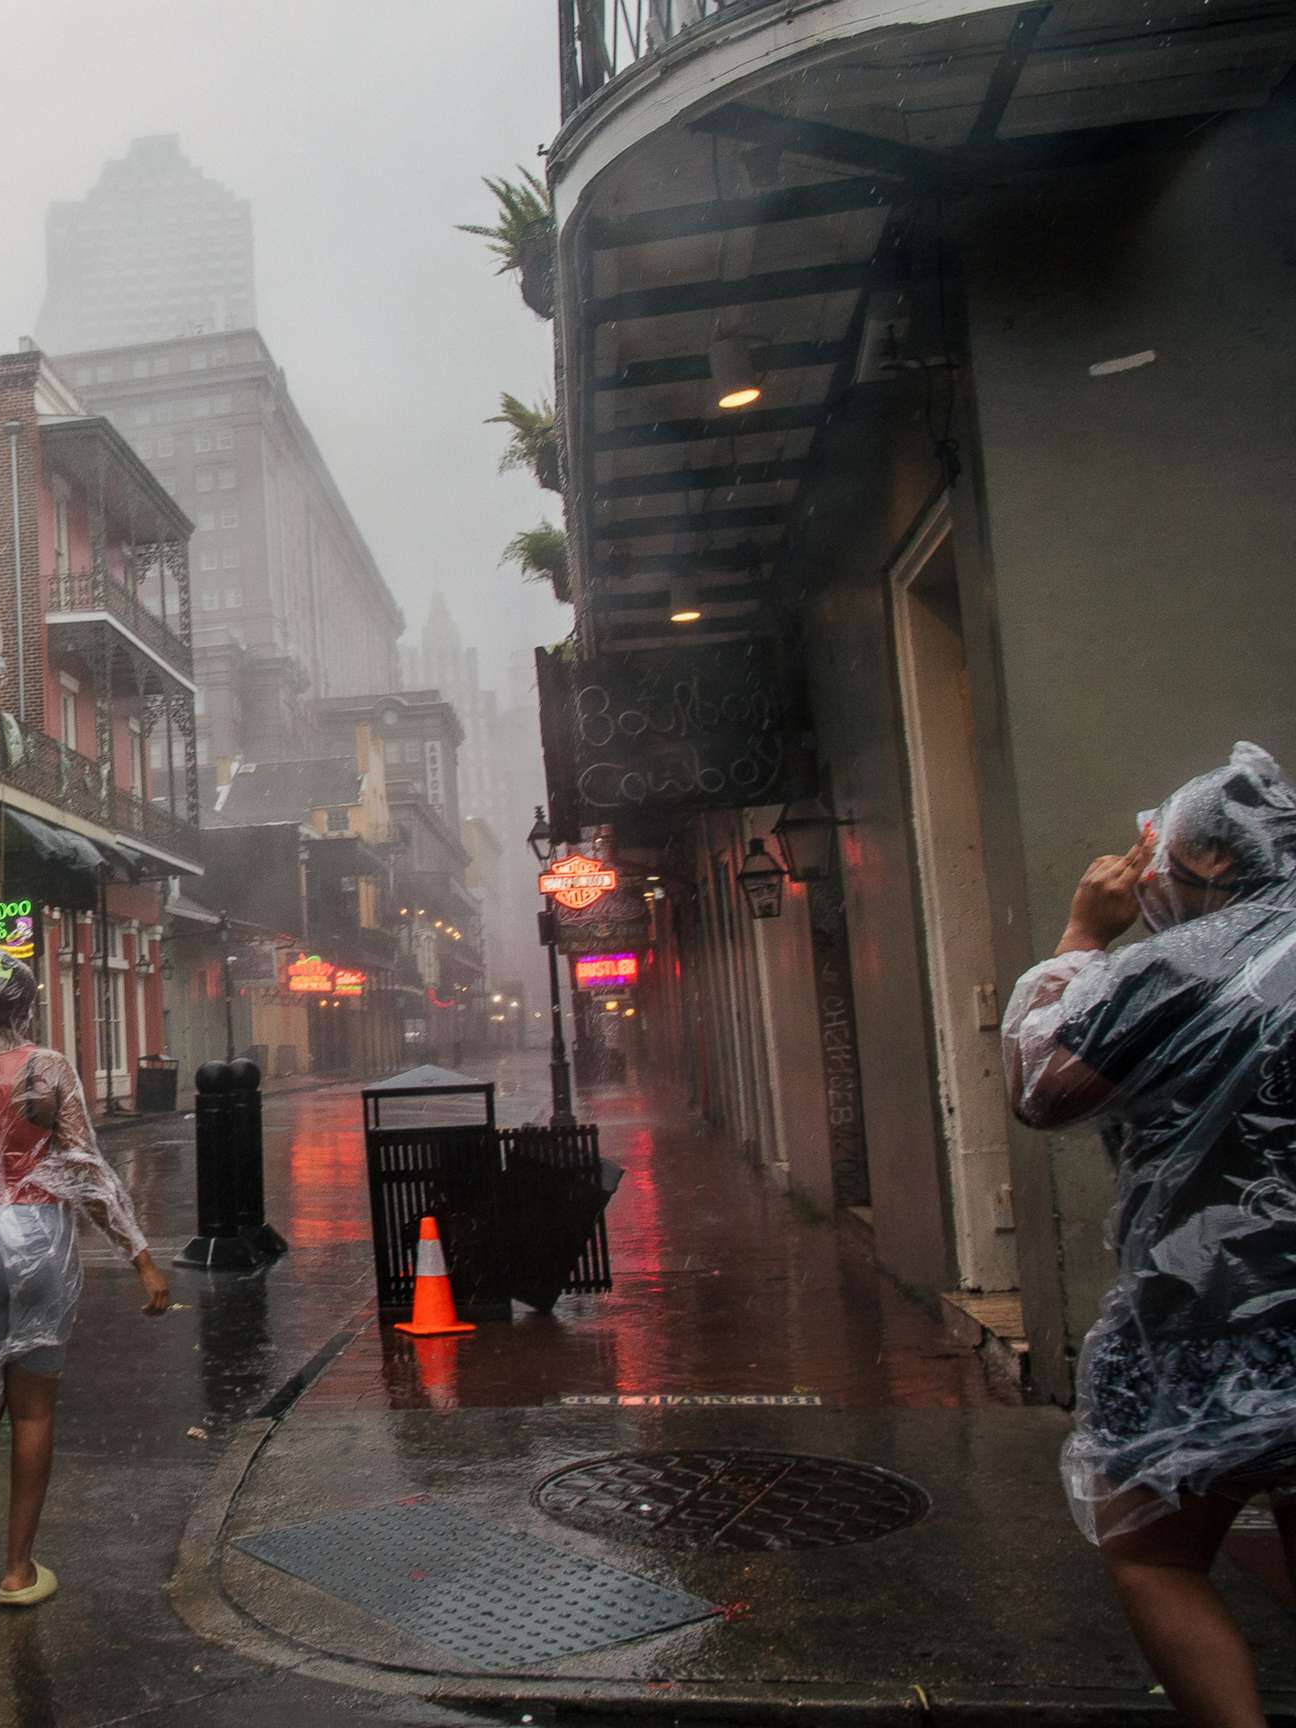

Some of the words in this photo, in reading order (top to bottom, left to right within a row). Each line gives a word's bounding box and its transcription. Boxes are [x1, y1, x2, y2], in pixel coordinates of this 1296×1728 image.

[576, 681, 769, 746] Bourbon
[577, 733, 783, 808] Cowboy
[577, 958, 636, 978] HUSTLER
